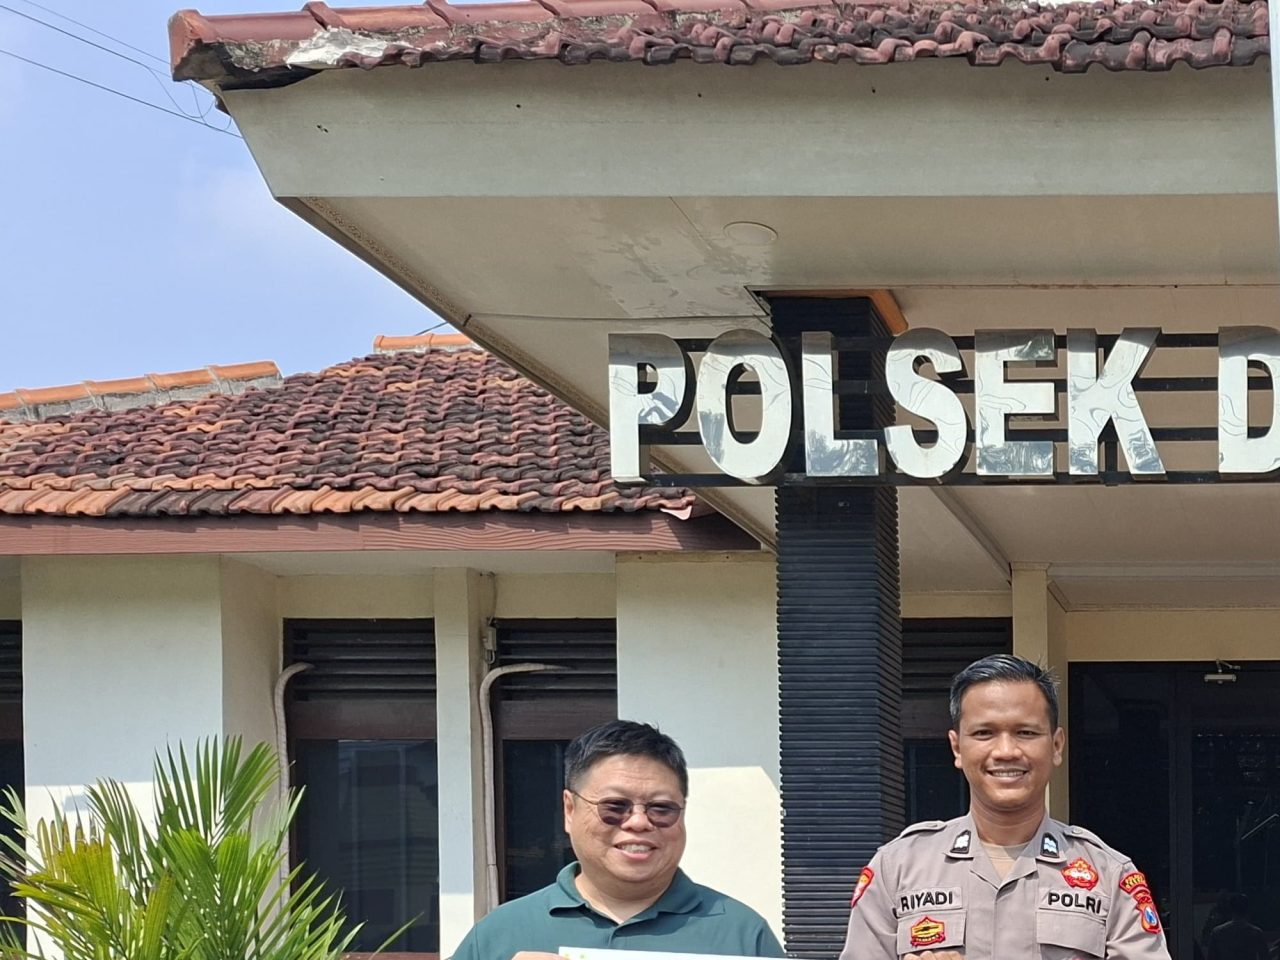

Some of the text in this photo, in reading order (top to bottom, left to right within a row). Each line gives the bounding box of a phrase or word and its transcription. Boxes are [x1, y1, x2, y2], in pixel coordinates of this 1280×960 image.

[608, 327, 1167, 483] POLSEK
[901, 891, 953, 912] RIYADI
[1047, 892, 1101, 914] POLRI
